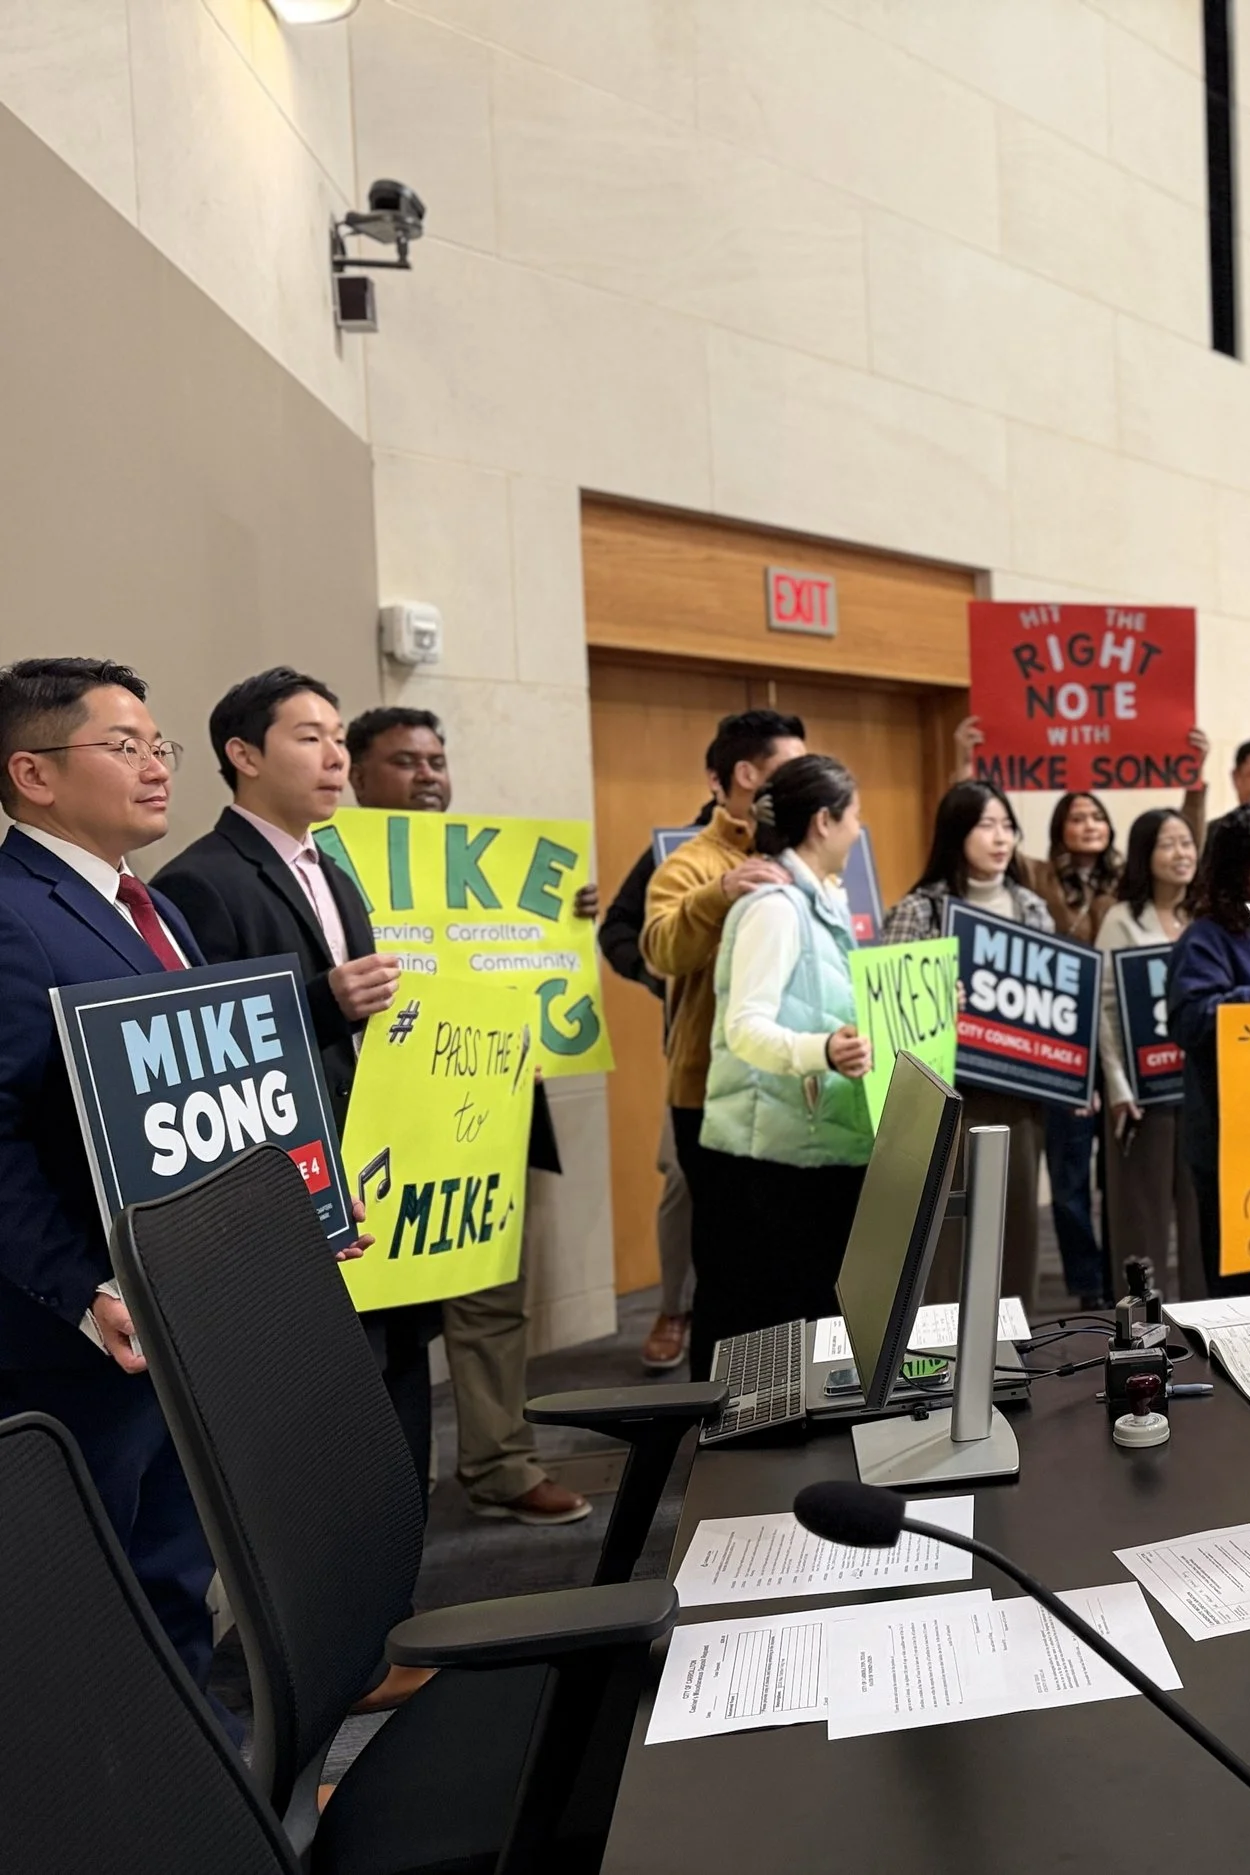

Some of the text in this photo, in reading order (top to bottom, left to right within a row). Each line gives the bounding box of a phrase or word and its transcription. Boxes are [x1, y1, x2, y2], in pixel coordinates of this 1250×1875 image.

[774, 574, 832, 628] EXIT
[1019, 604, 1147, 632] HIT THE
[1012, 631, 1162, 680] RIGHT
[1026, 682, 1138, 720] NOTE
[1047, 725, 1111, 746] WITH
[976, 755, 1199, 790] MIKE SONG
[372, 923, 434, 944] erving
[973, 924, 1081, 995] MIKE
[969, 969, 1078, 1036] SONG
[120, 994, 283, 1095] MIKE
[431, 1021, 481, 1077] PASS
[486, 1030, 513, 1076] THE
[957, 1021, 984, 1039] CITY
[985, 1029, 1032, 1054] COUNCIL
[1041, 1044, 1072, 1065] PLACE
[1074, 1053, 1082, 1066] 4
[1147, 1051, 1178, 1067] CITY
[144, 1070, 298, 1177] SONG
[454, 1091, 489, 1142] to
[311, 1157, 320, 1175] 4
[387, 1172, 501, 1260] MIKE
